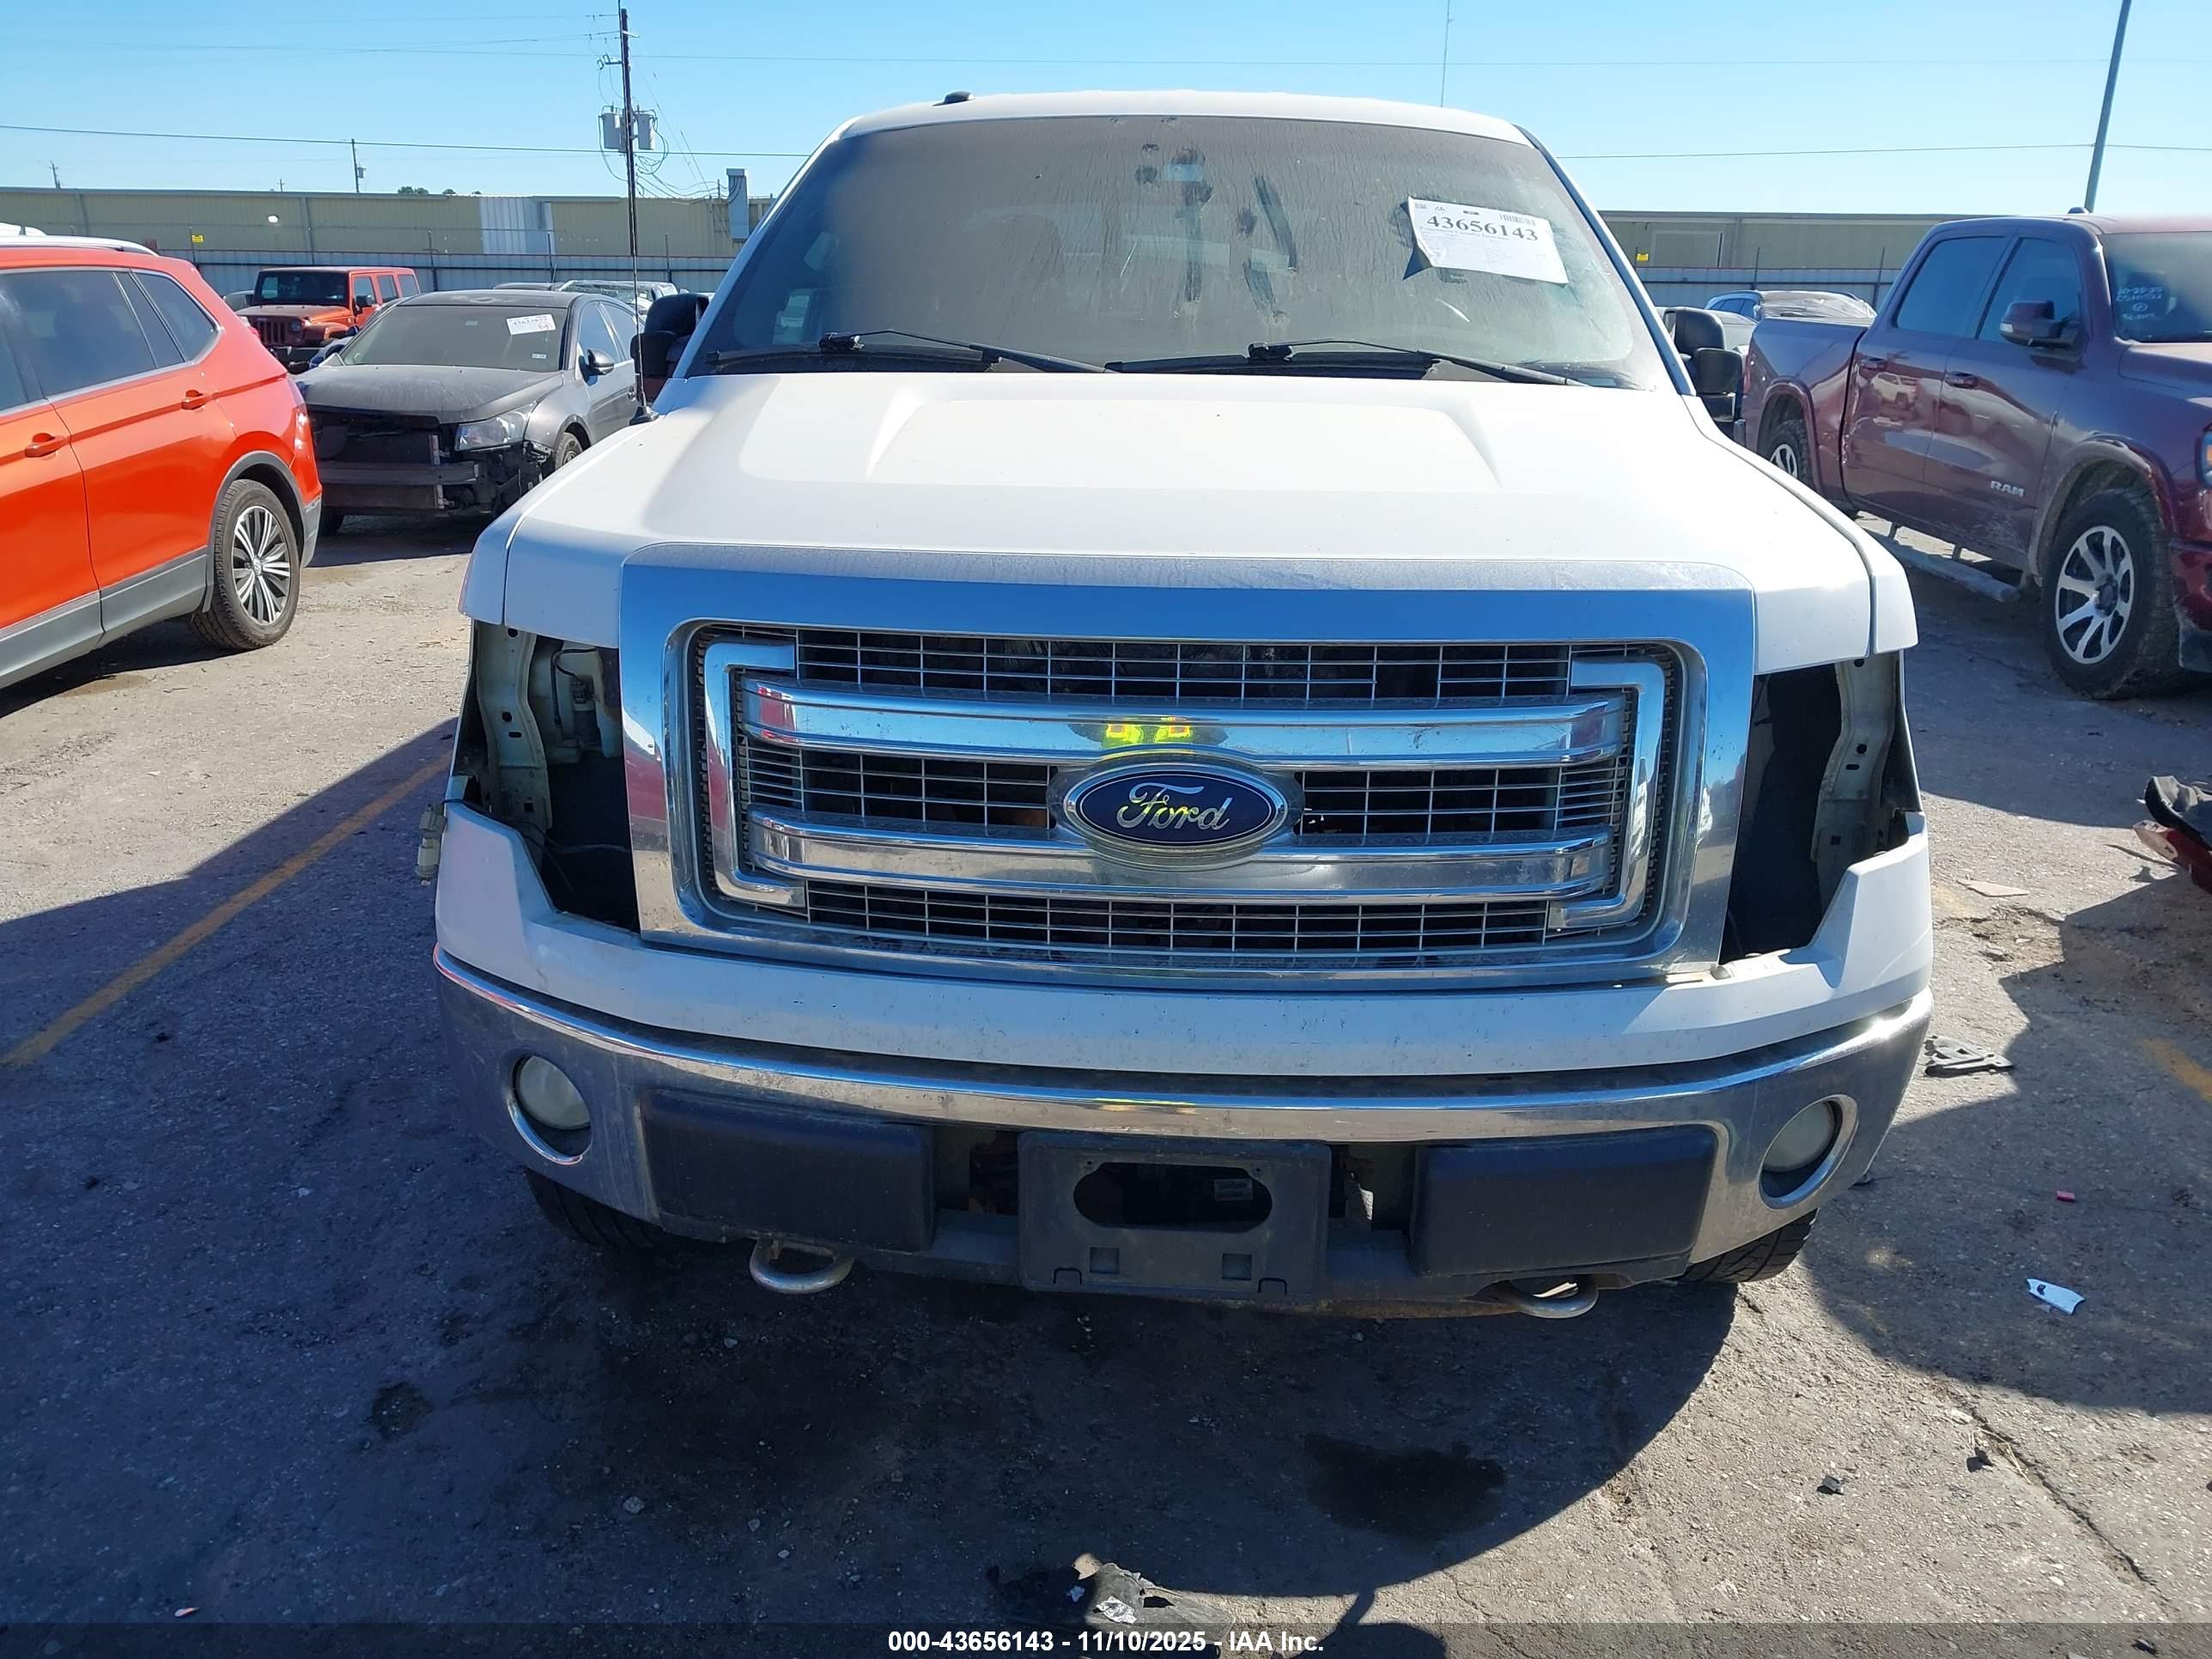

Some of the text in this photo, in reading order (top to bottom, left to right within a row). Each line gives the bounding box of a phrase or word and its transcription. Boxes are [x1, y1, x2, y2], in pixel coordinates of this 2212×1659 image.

[1426, 215, 1539, 241] 43656143
[1990, 480, 2025, 497] RAM
[1116, 782, 1233, 830] Ford
